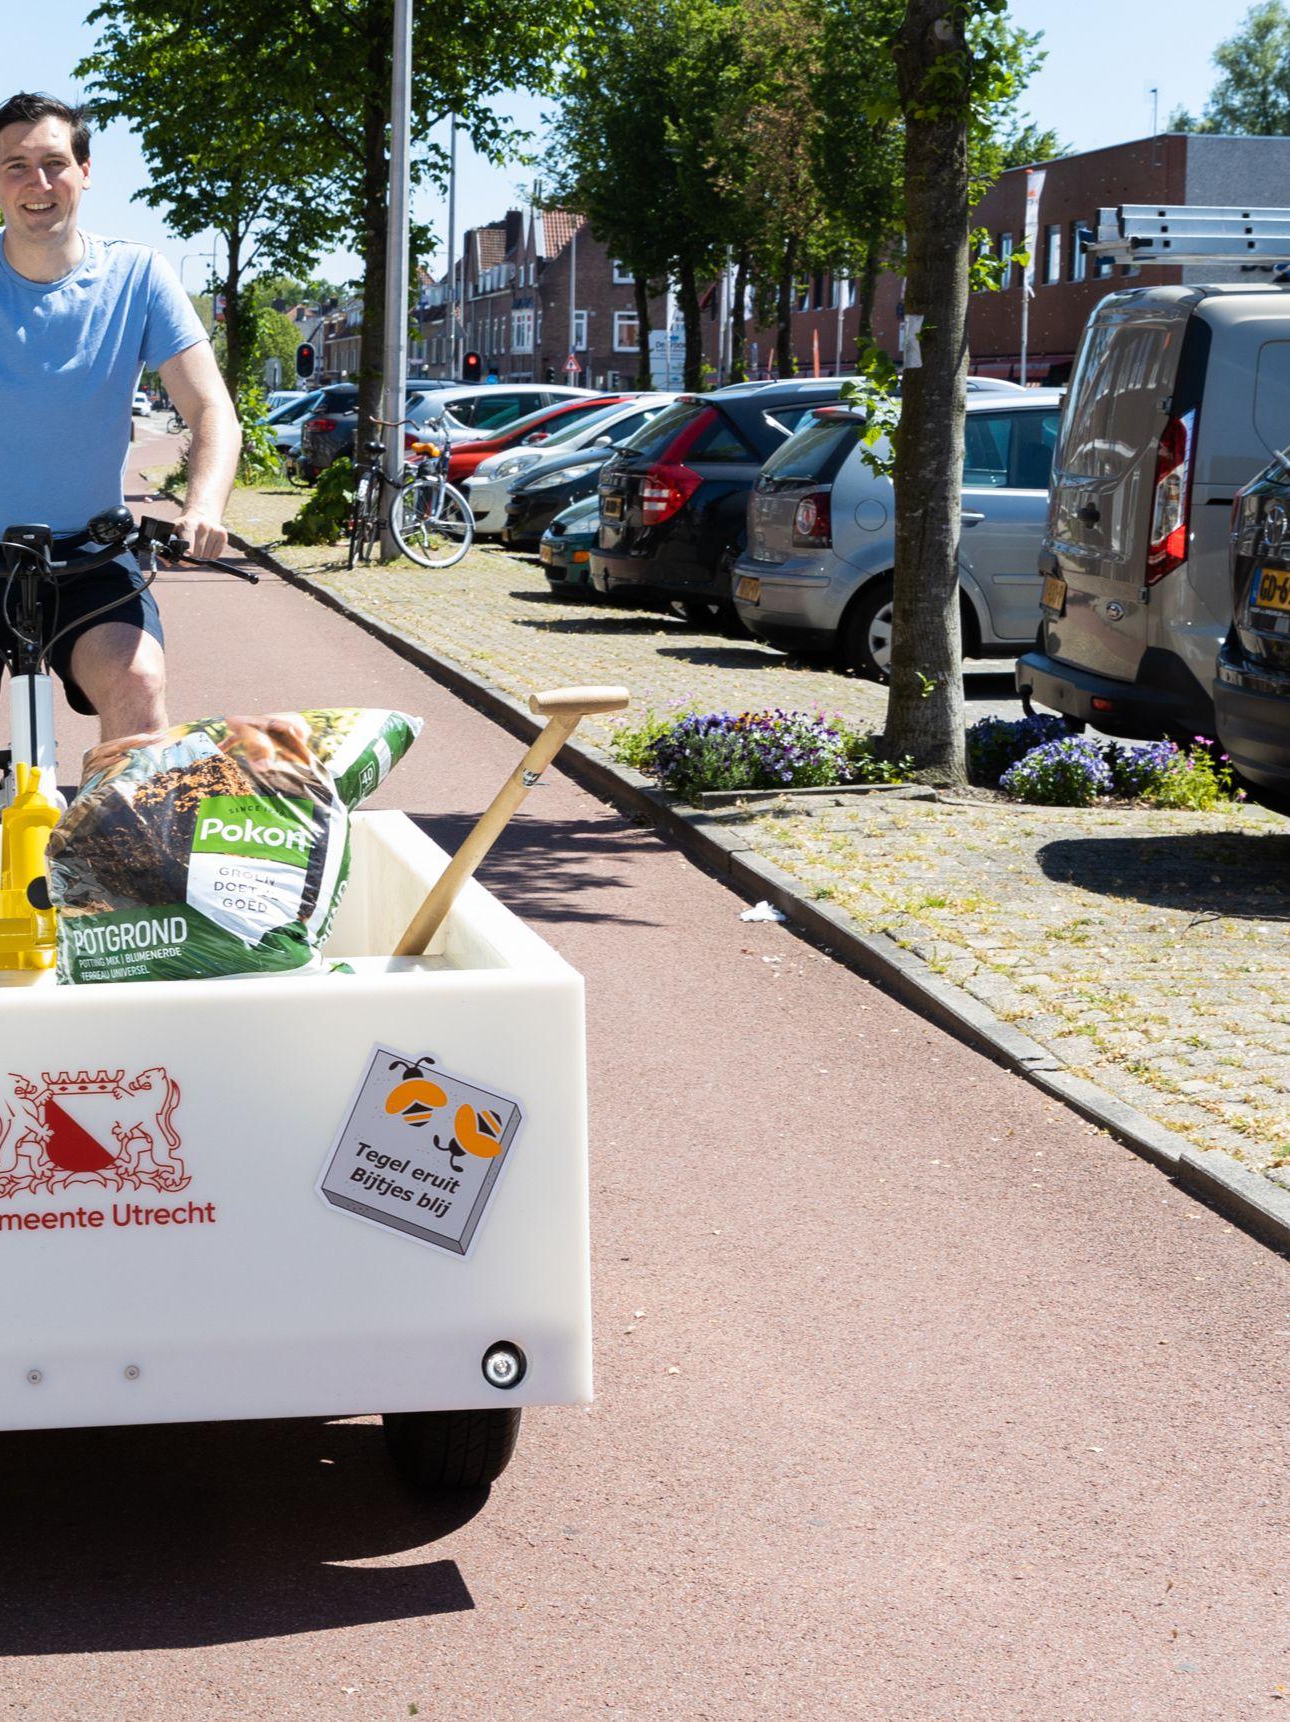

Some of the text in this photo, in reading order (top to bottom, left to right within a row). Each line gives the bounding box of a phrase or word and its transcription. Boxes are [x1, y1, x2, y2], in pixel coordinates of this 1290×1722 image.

[1260, 574, 1290, 605] GD-6
[361, 767, 374, 785] 40
[228, 804, 261, 814] SINCE
[199, 817, 307, 853] Pokon
[222, 897, 268, 913] GOED
[73, 916, 188, 956] POTGROND
[78, 946, 183, 969] POTTING MIX BLUMENERDE
[81, 964, 151, 982] TERREAU UNIVERSEL
[355, 1141, 461, 1194] Tegel eruit
[349, 1167, 452, 1219] Bijtjes blij
[112, 1201, 216, 1227] Utrecht
